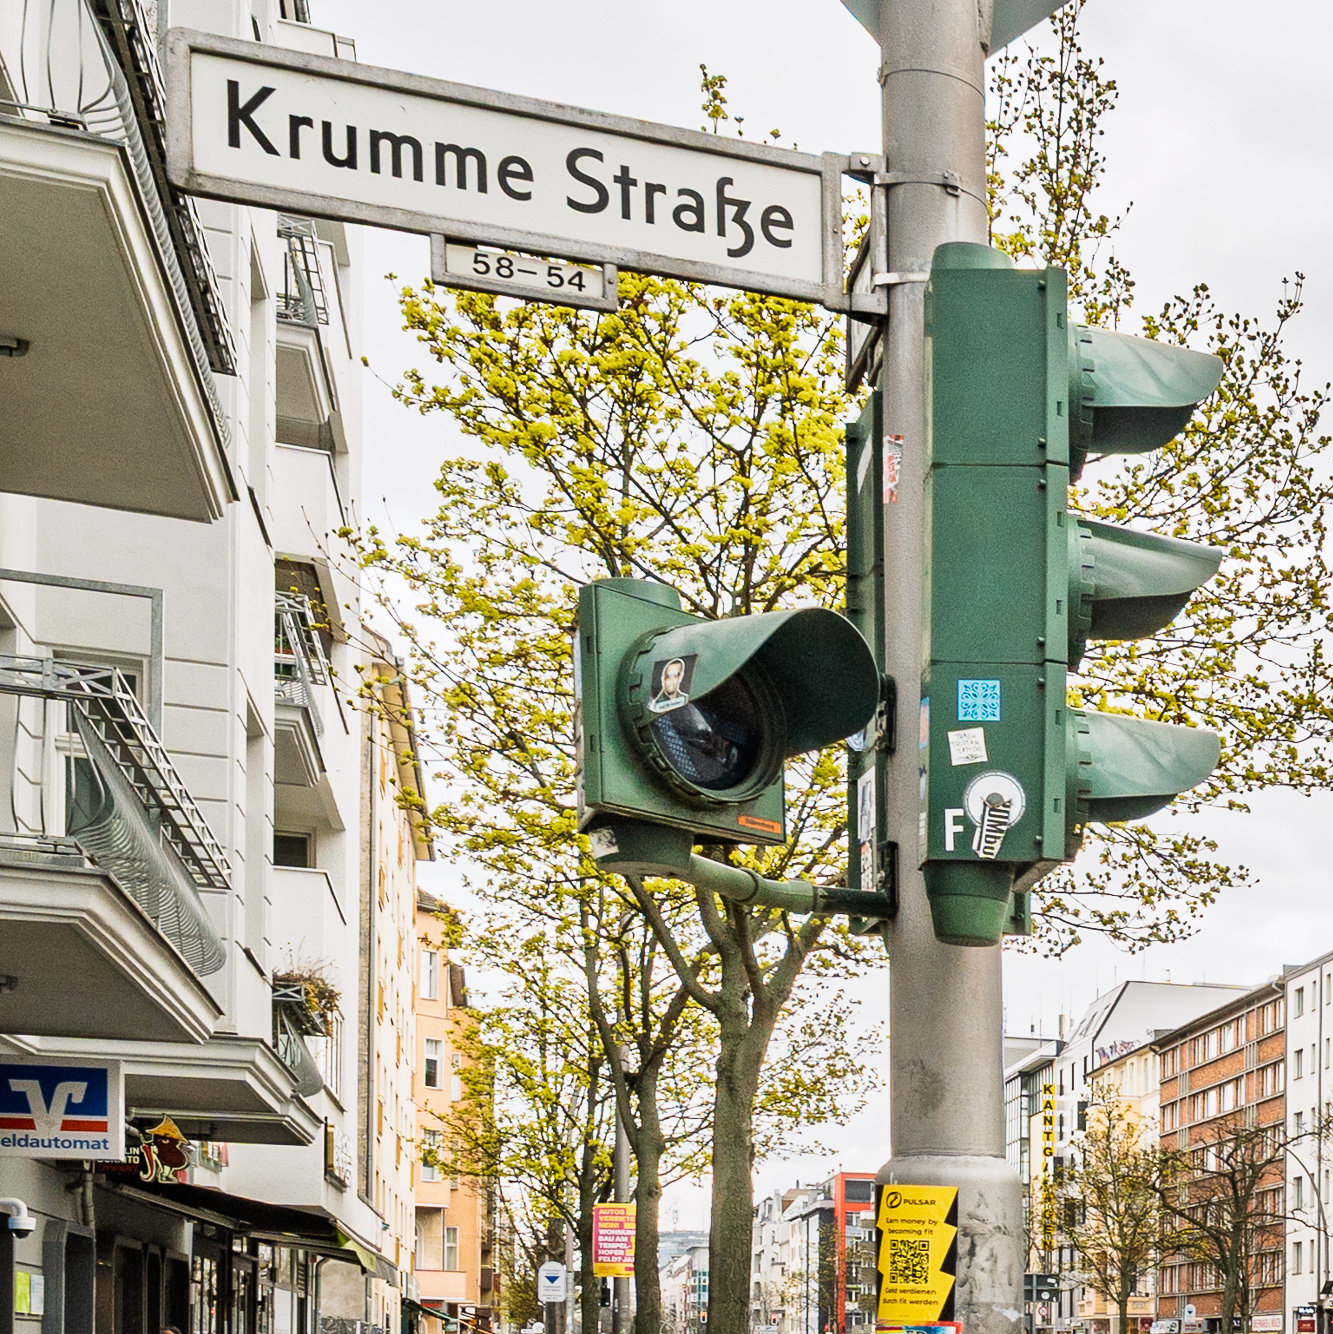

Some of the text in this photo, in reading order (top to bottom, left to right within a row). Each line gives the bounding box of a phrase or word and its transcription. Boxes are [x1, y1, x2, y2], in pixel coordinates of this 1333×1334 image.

[226, 79, 795, 258] Krumme Straße
[945, 808, 964, 851] F
[1, 1133, 109, 1150] eldautomat
[903, 1198, 936, 1206] PULSAR
[900, 1218, 925, 1226] money
[928, 1218, 938, 1226] by
[888, 1228, 922, 1236] becoming
